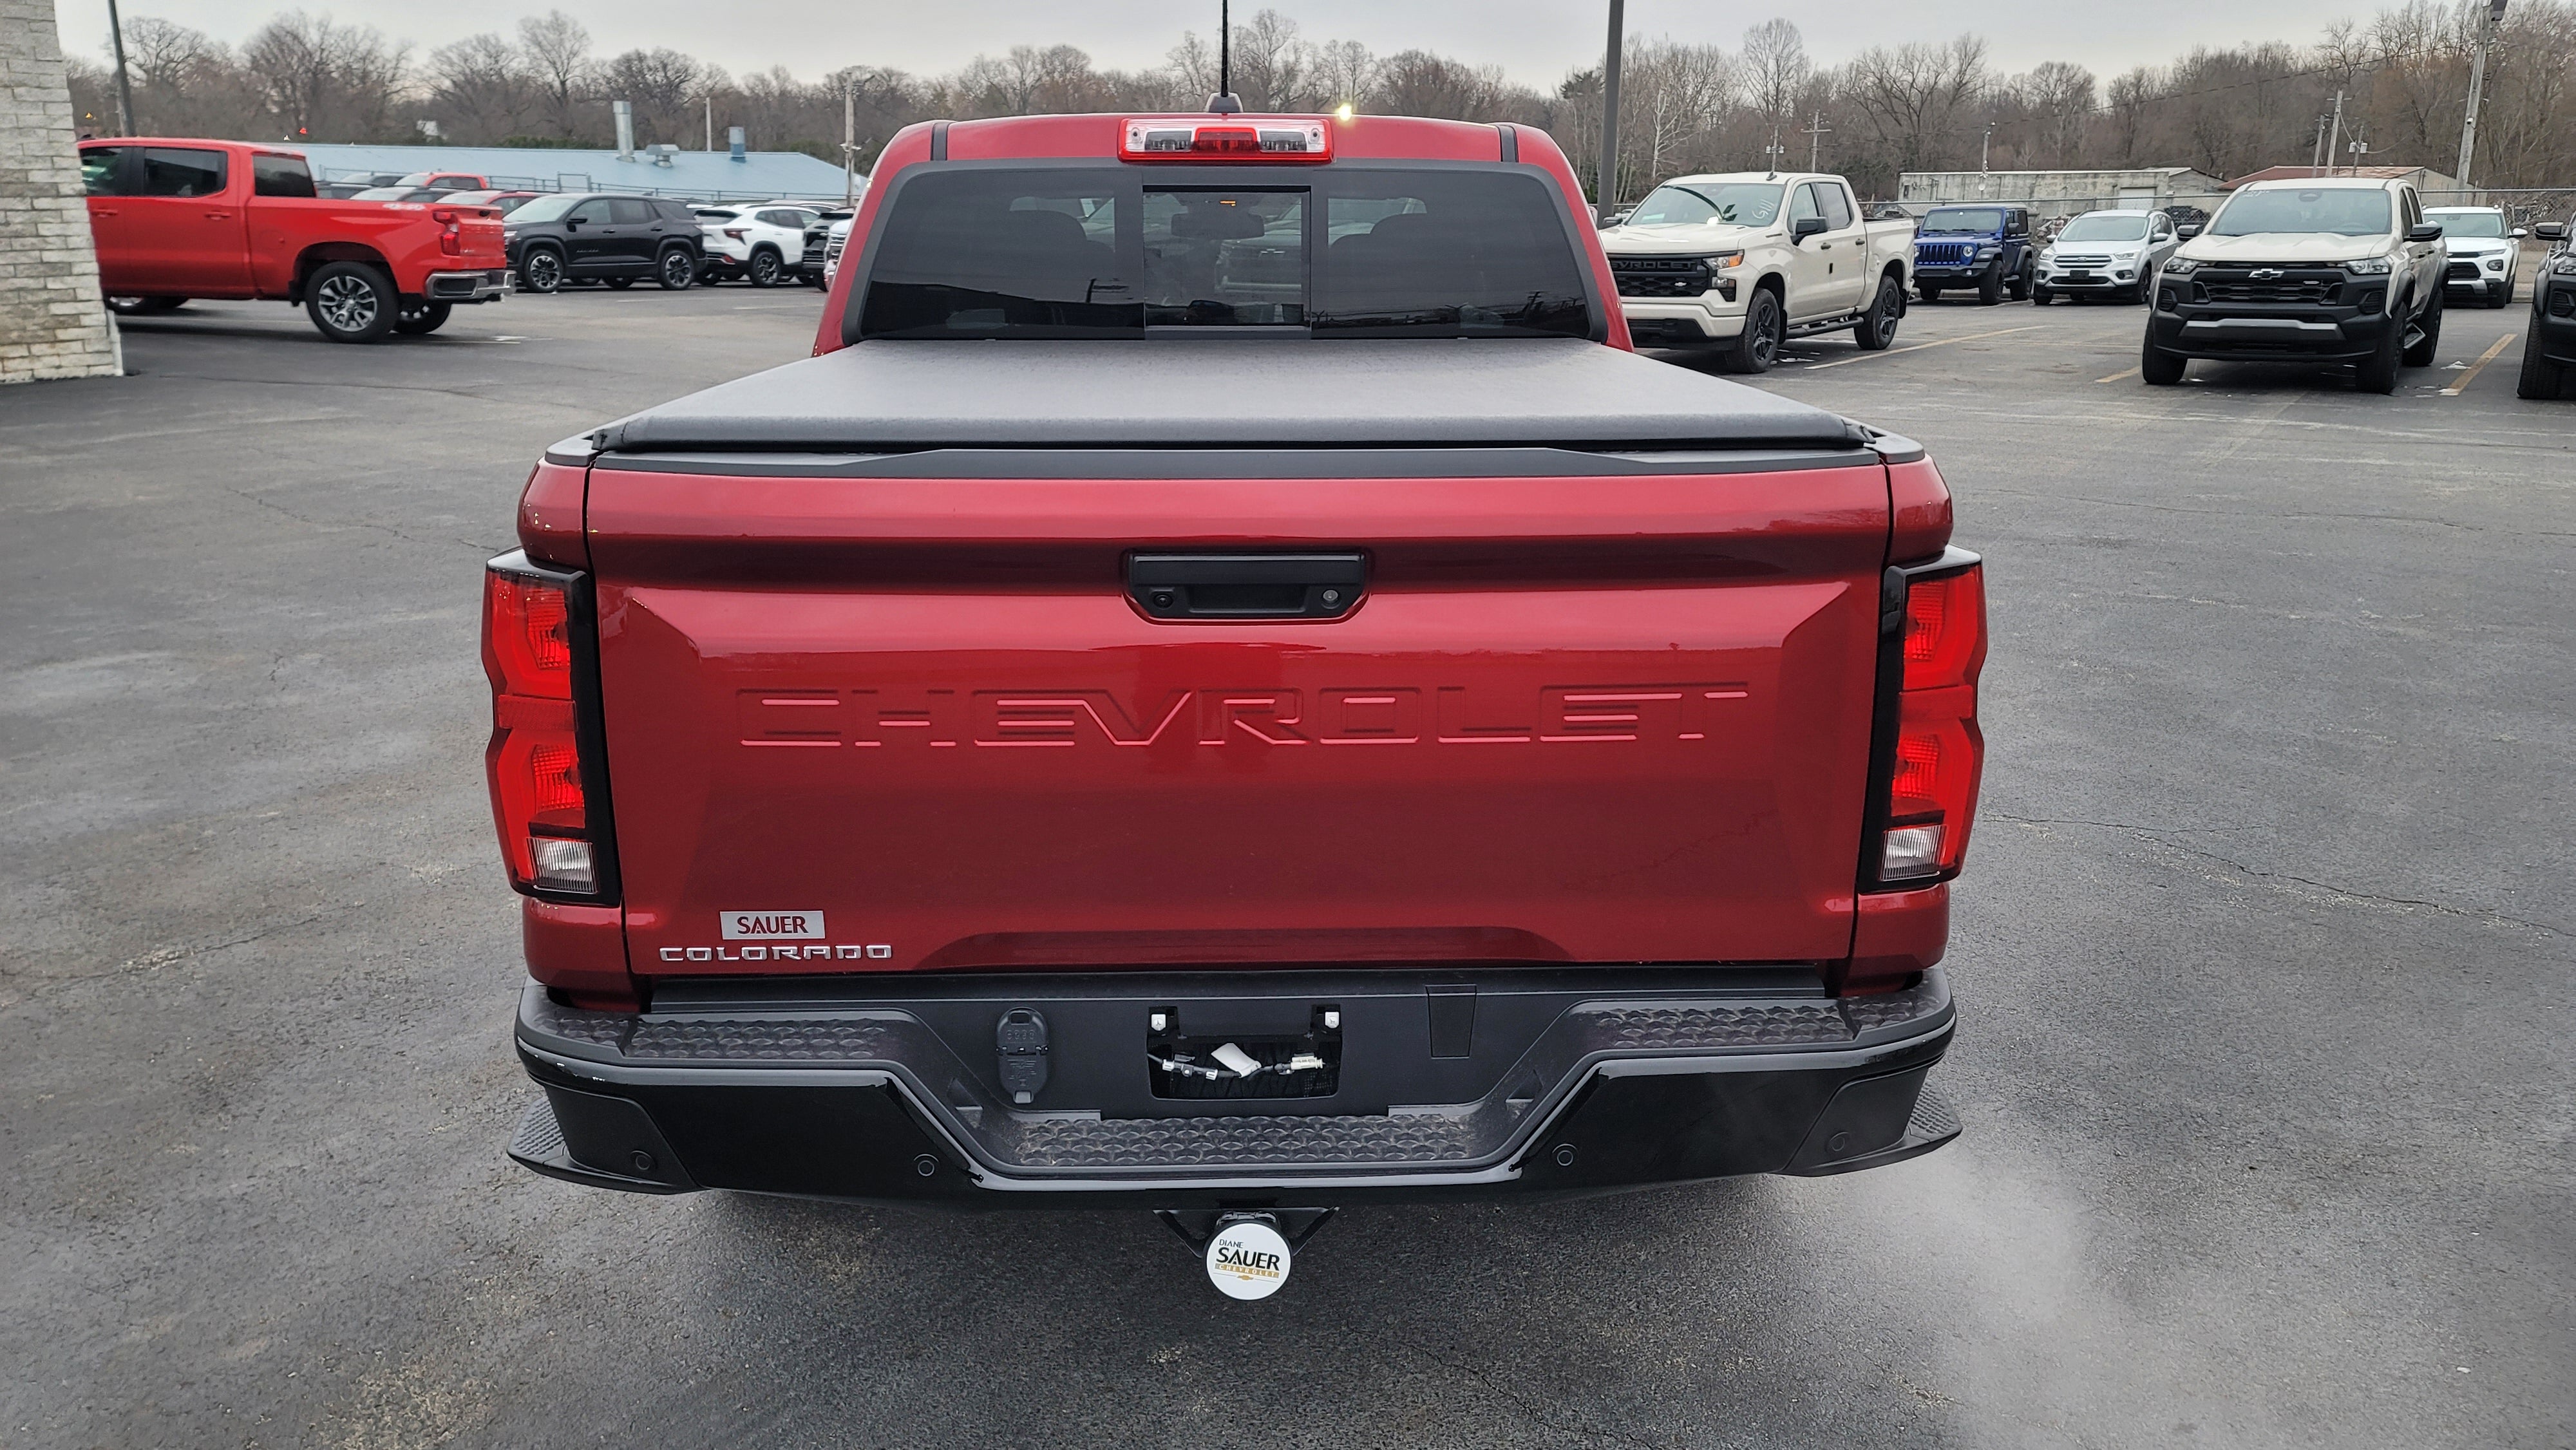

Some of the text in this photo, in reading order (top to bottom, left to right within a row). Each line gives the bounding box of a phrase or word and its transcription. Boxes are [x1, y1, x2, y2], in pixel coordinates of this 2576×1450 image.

[1611, 260, 1696, 269] EVROLET
[736, 681, 1748, 747] CHEVROLET
[737, 916, 809, 934] SAUER
[659, 945, 892, 961] COLORADO
[1218, 1239, 1244, 1248] DIANE
[1216, 1247, 1280, 1271] SAUER
[1218, 1264, 1276, 1277] CHEVROLET
